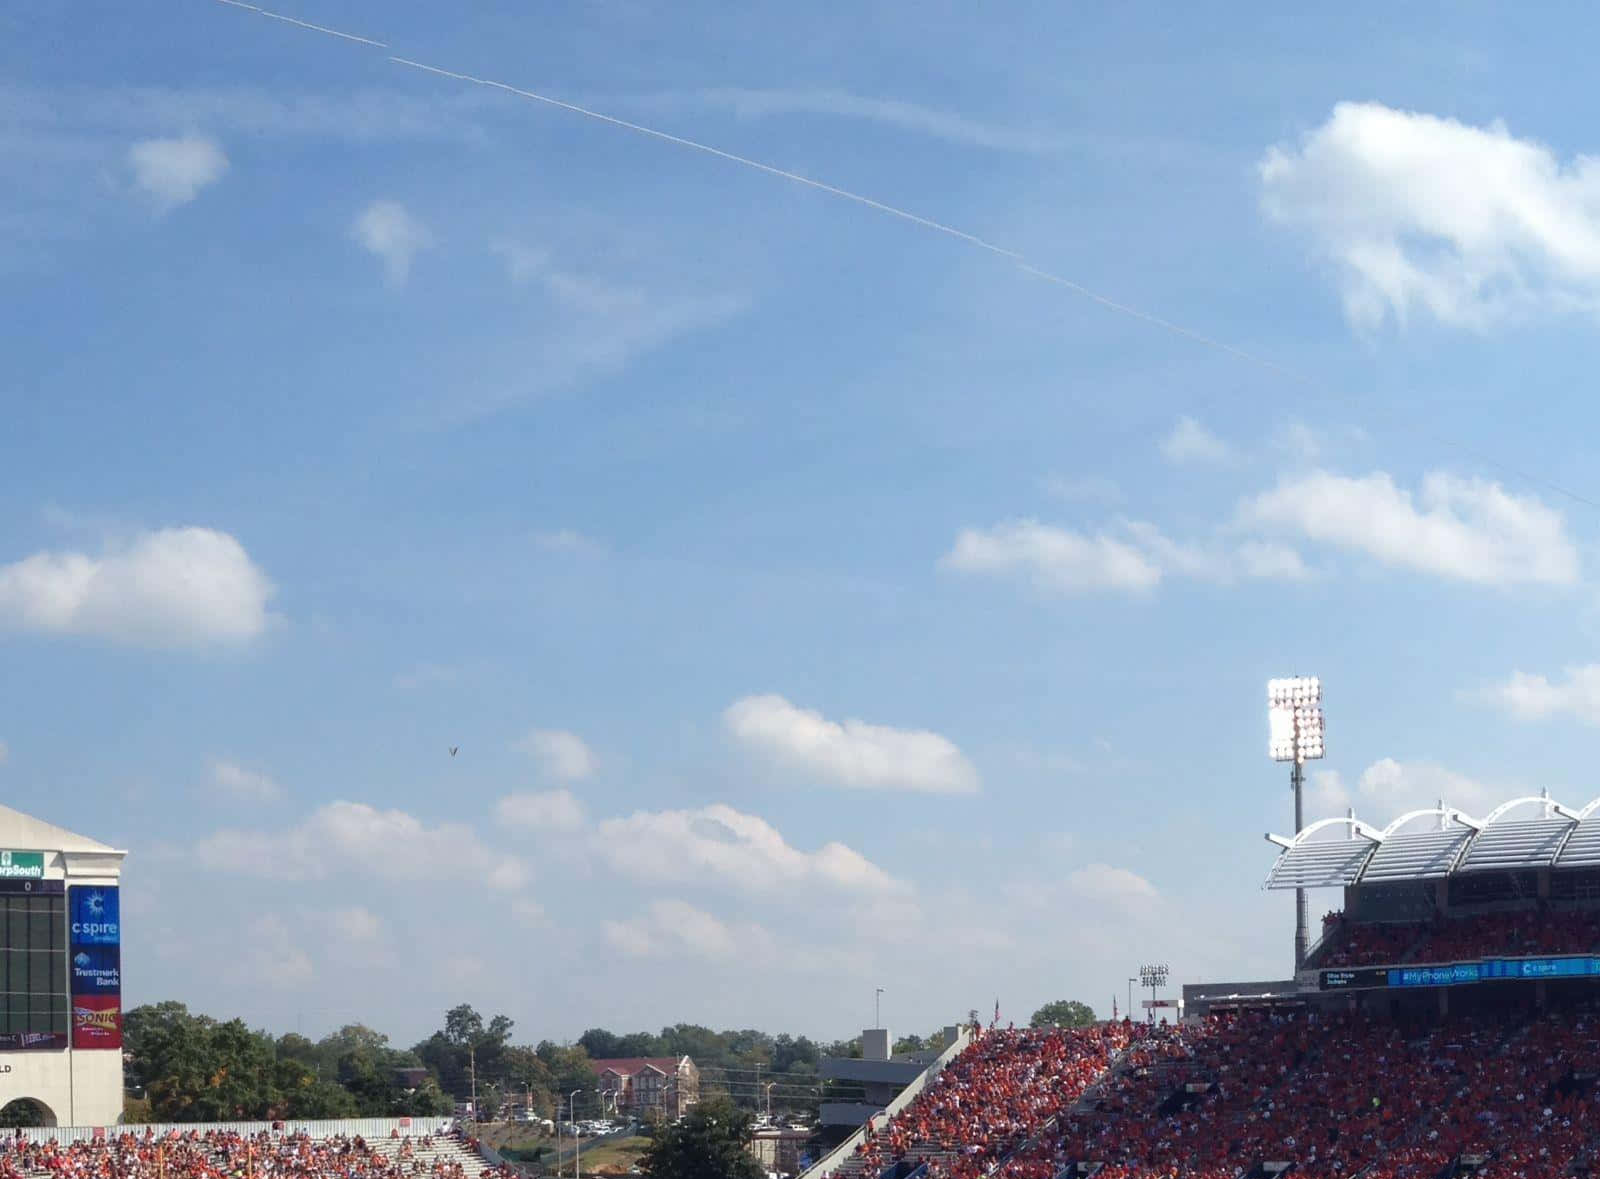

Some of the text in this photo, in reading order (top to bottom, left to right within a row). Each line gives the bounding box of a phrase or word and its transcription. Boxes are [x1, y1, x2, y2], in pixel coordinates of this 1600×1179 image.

[24, 881, 32, 891] 0
[82, 922, 118, 936] spire
[74, 967, 119, 977] Trustmark
[1402, 968, 1479, 982] #MyPhoneWorks
[96, 976, 119, 987] Bank
[77, 1012, 116, 1023] SONIC
